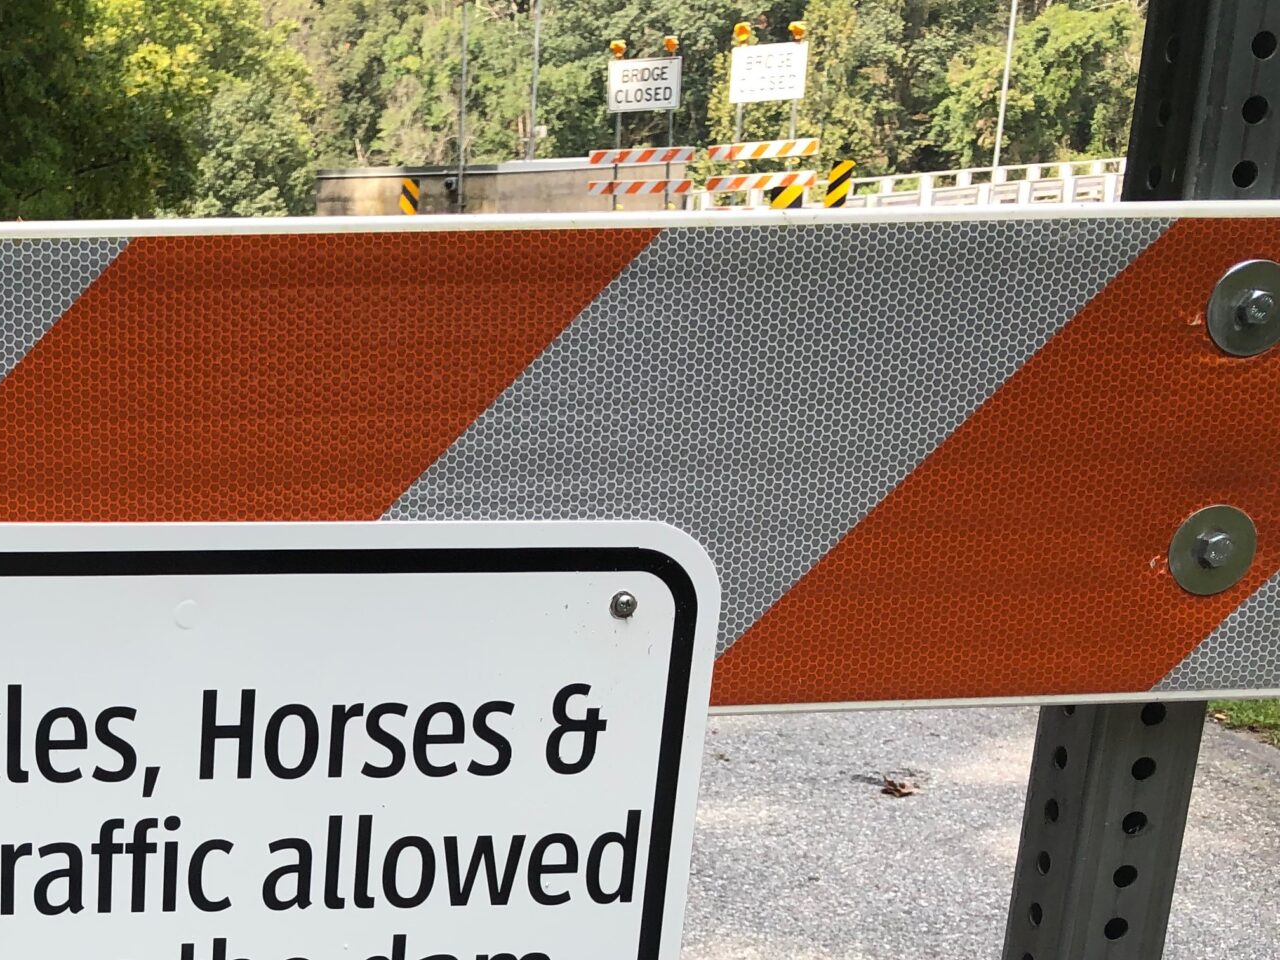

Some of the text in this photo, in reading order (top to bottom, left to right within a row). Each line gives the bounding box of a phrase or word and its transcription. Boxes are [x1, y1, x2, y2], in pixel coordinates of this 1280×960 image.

[614, 86, 672, 104] CLOSED
[622, 66, 669, 83] BRIDGE
[200, 689, 514, 780] Horses
[546, 683, 607, 774] &
[263, 810, 641, 910] allowed
